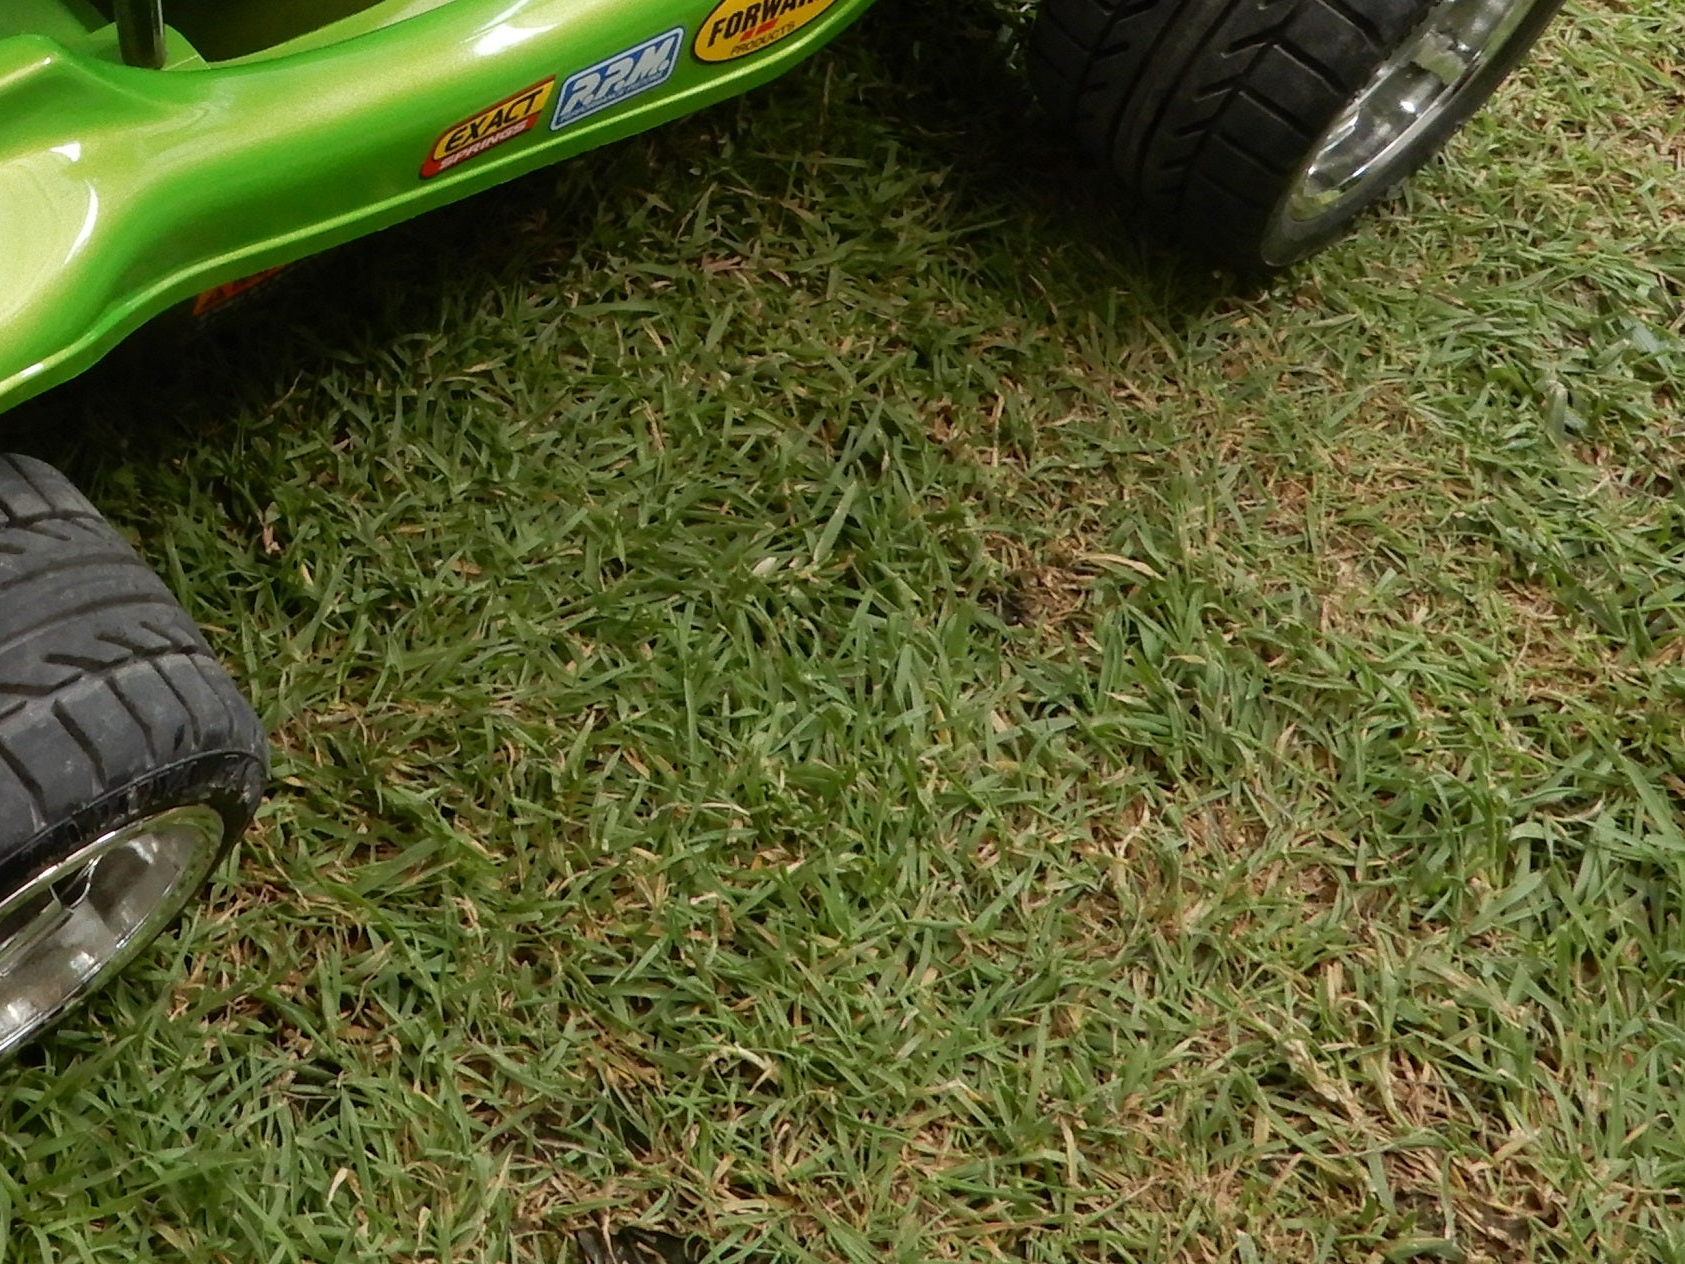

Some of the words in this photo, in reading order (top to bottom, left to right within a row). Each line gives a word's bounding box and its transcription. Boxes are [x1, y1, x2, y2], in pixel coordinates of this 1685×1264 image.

[731, 21, 795, 55] PRODUCTS
[439, 119, 529, 170] SPRINGS
[445, 89, 543, 153] EXACT
